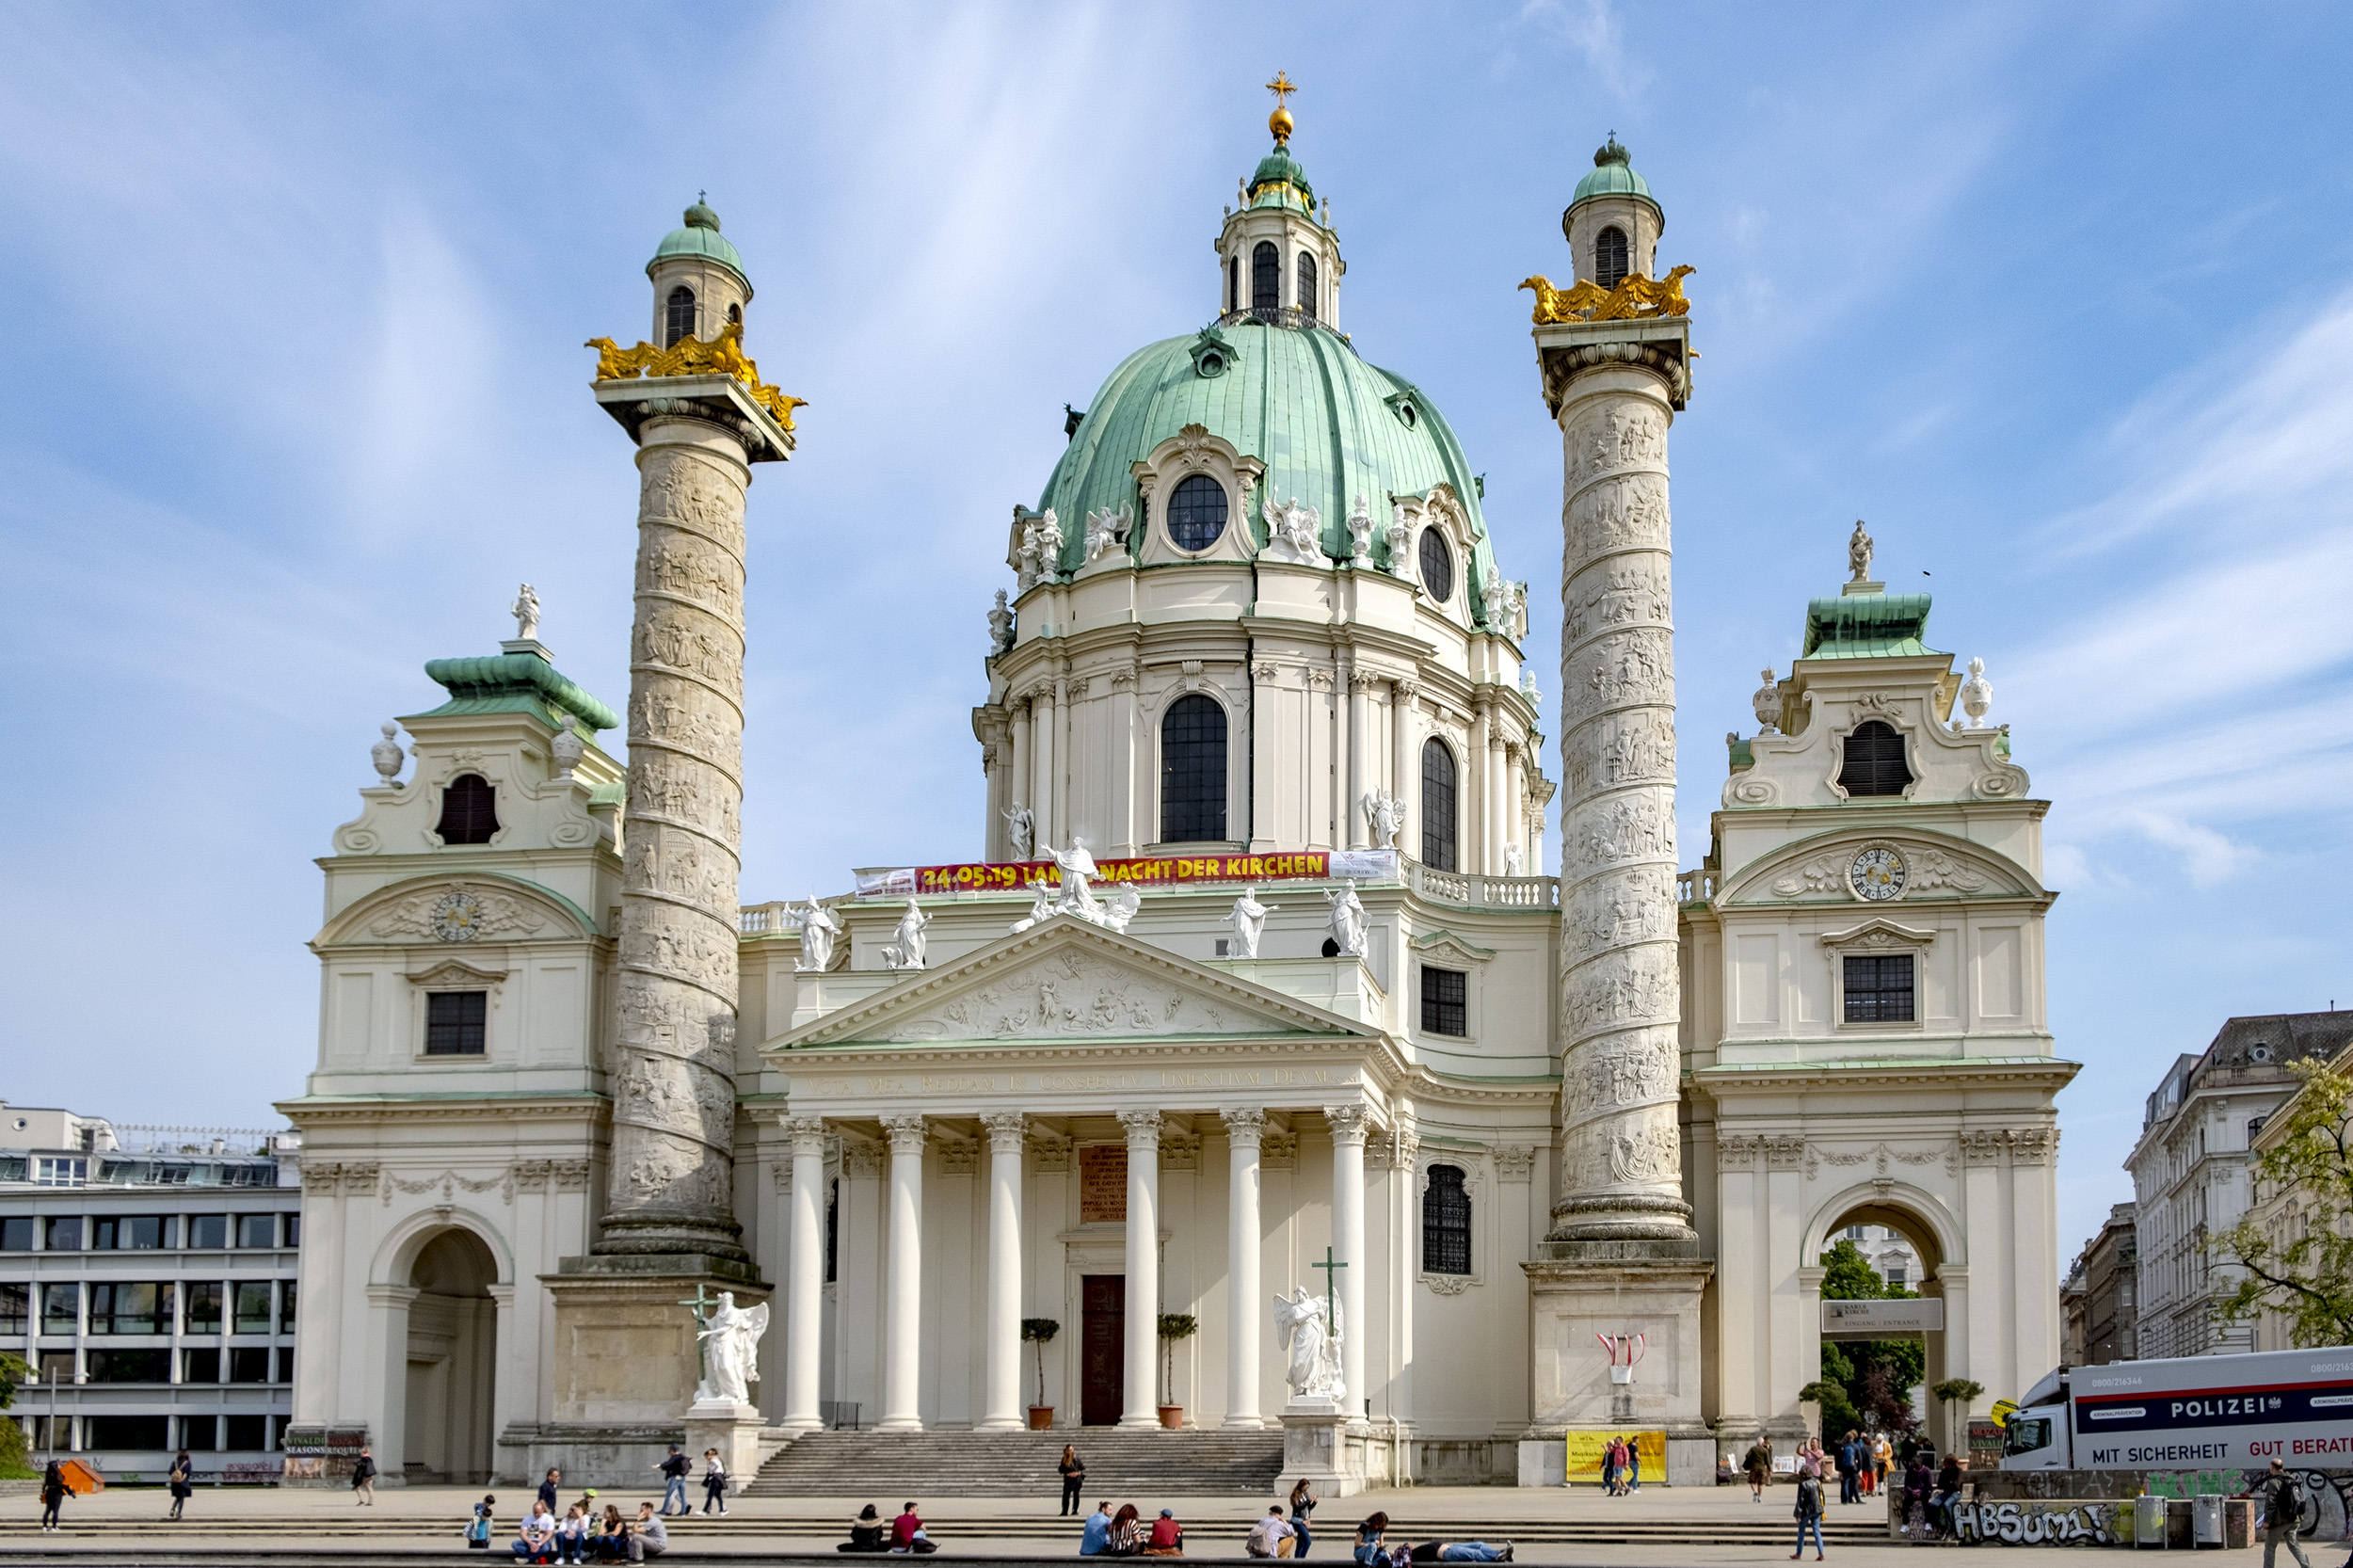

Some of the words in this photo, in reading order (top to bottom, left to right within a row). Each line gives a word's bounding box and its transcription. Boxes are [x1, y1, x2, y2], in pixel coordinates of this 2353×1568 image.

[923, 866, 1017, 888] 24.05.19
[1099, 861, 1173, 882] NACHT
[1177, 858, 1221, 878] DER
[1226, 855, 1323, 876] KIRCHEN
[808, 1078, 853, 1095] VOTA
[867, 1077, 908, 1095] MEA
[920, 1076, 995, 1093] REDDAM
[2091, 1376, 2143, 1387] 0800/216346
[2170, 1397, 2265, 1418] POLIZEI
[286, 1446, 325, 1454] SEASONS
[287, 1437, 325, 1446] VIVALDI
[2092, 1448, 2120, 1464] MIT
[2128, 1443, 2229, 1462] SICHERHEIT
[2249, 1440, 2284, 1456] GUT
